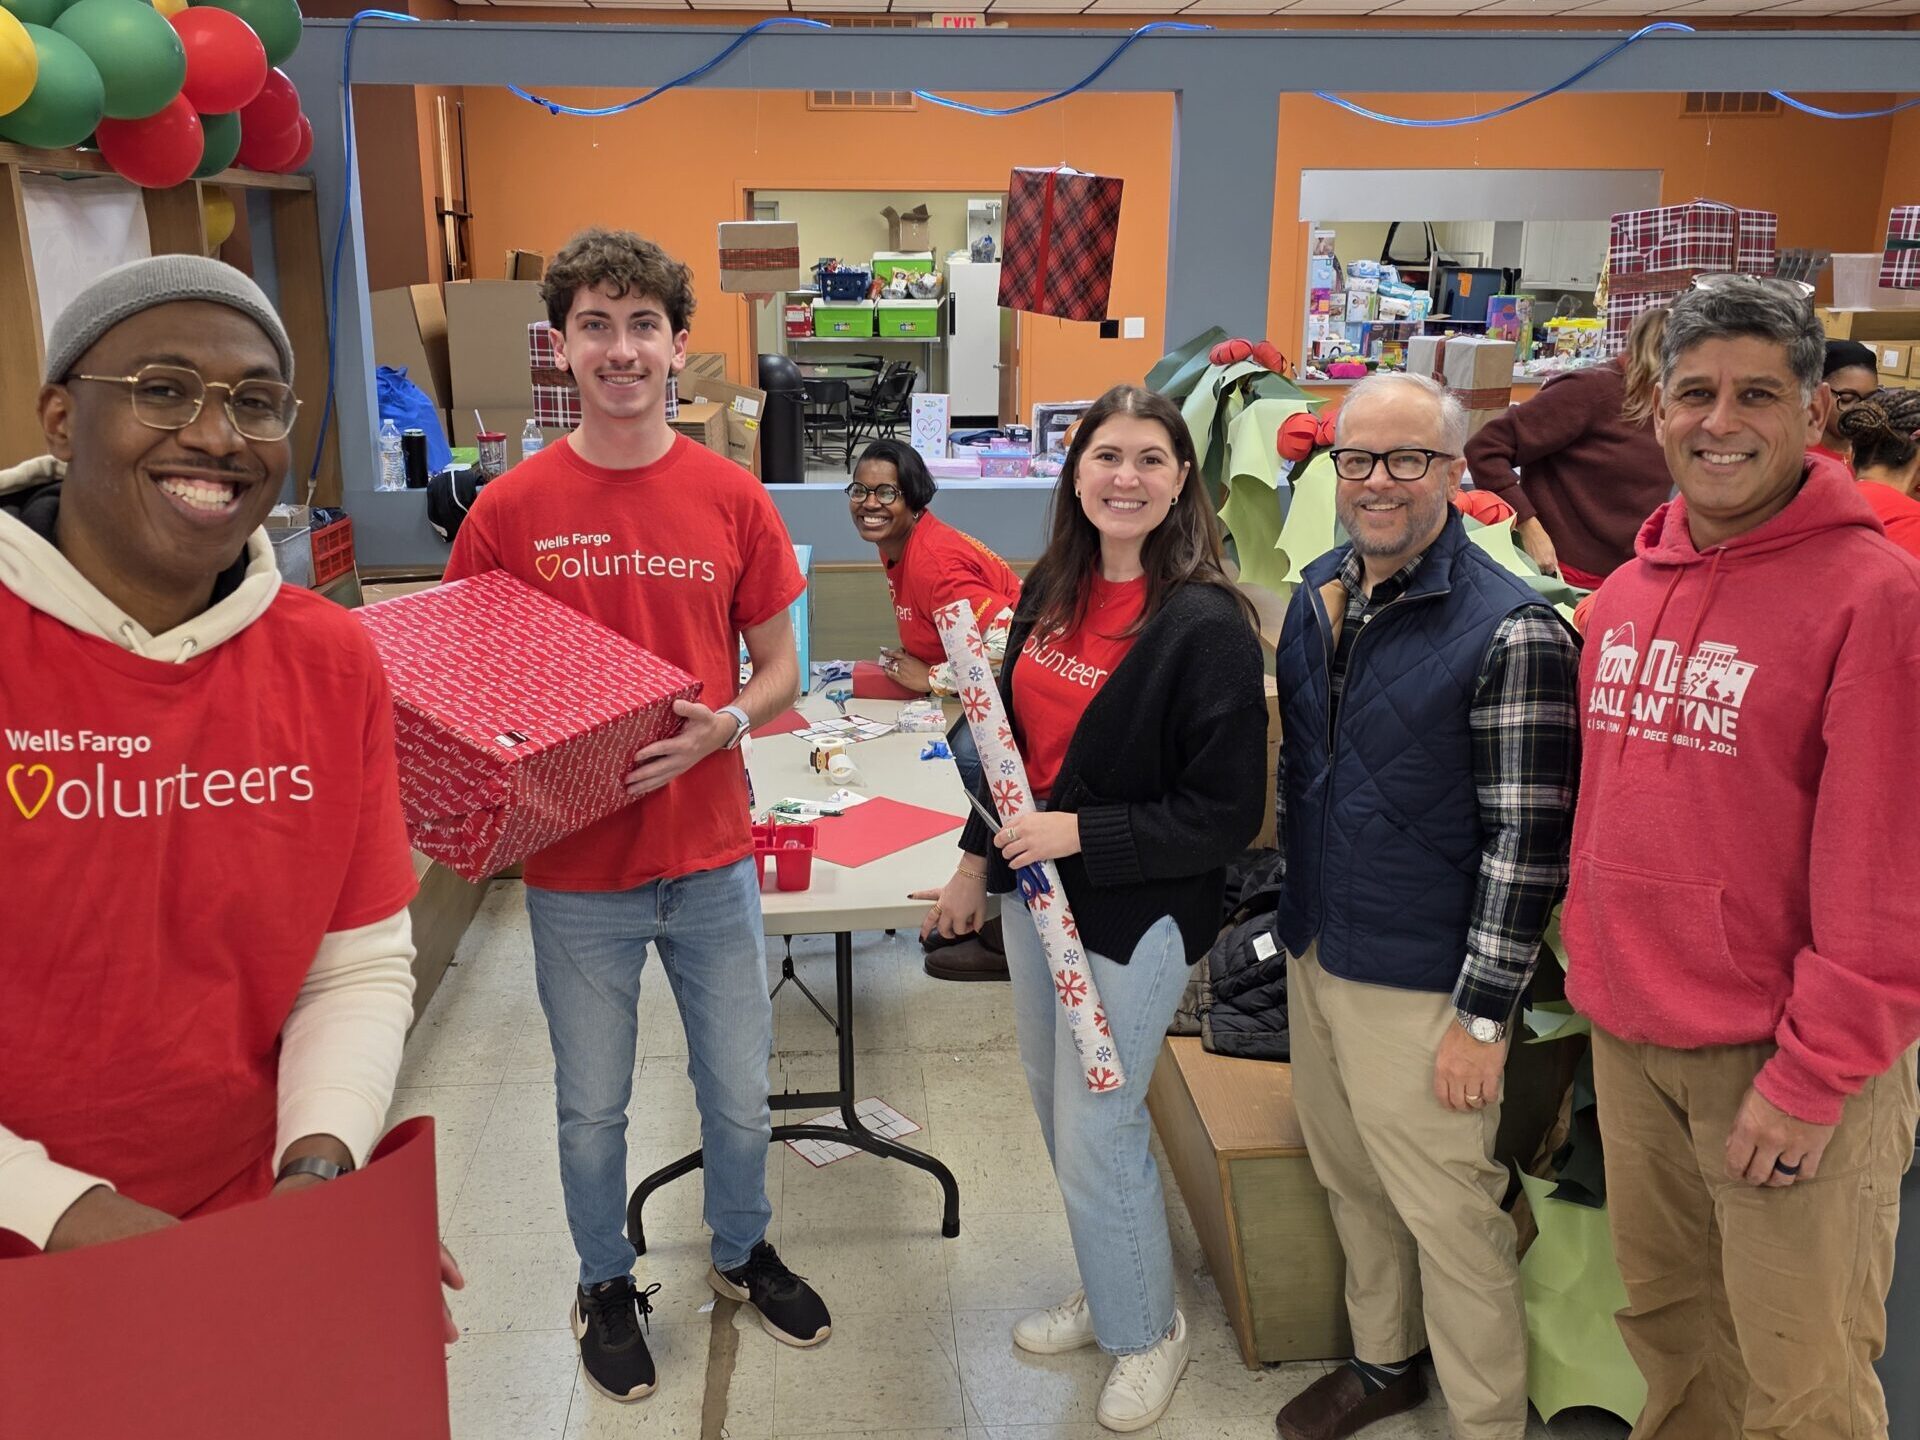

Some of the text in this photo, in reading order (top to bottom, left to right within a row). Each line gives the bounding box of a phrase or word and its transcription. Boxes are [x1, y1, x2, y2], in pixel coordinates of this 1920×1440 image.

[534, 533, 611, 551] Wells Fargo
[1022, 635, 1108, 689] olunteer
[5, 729, 151, 758] Wells Fargo
[1708, 740, 1737, 757] 2021
